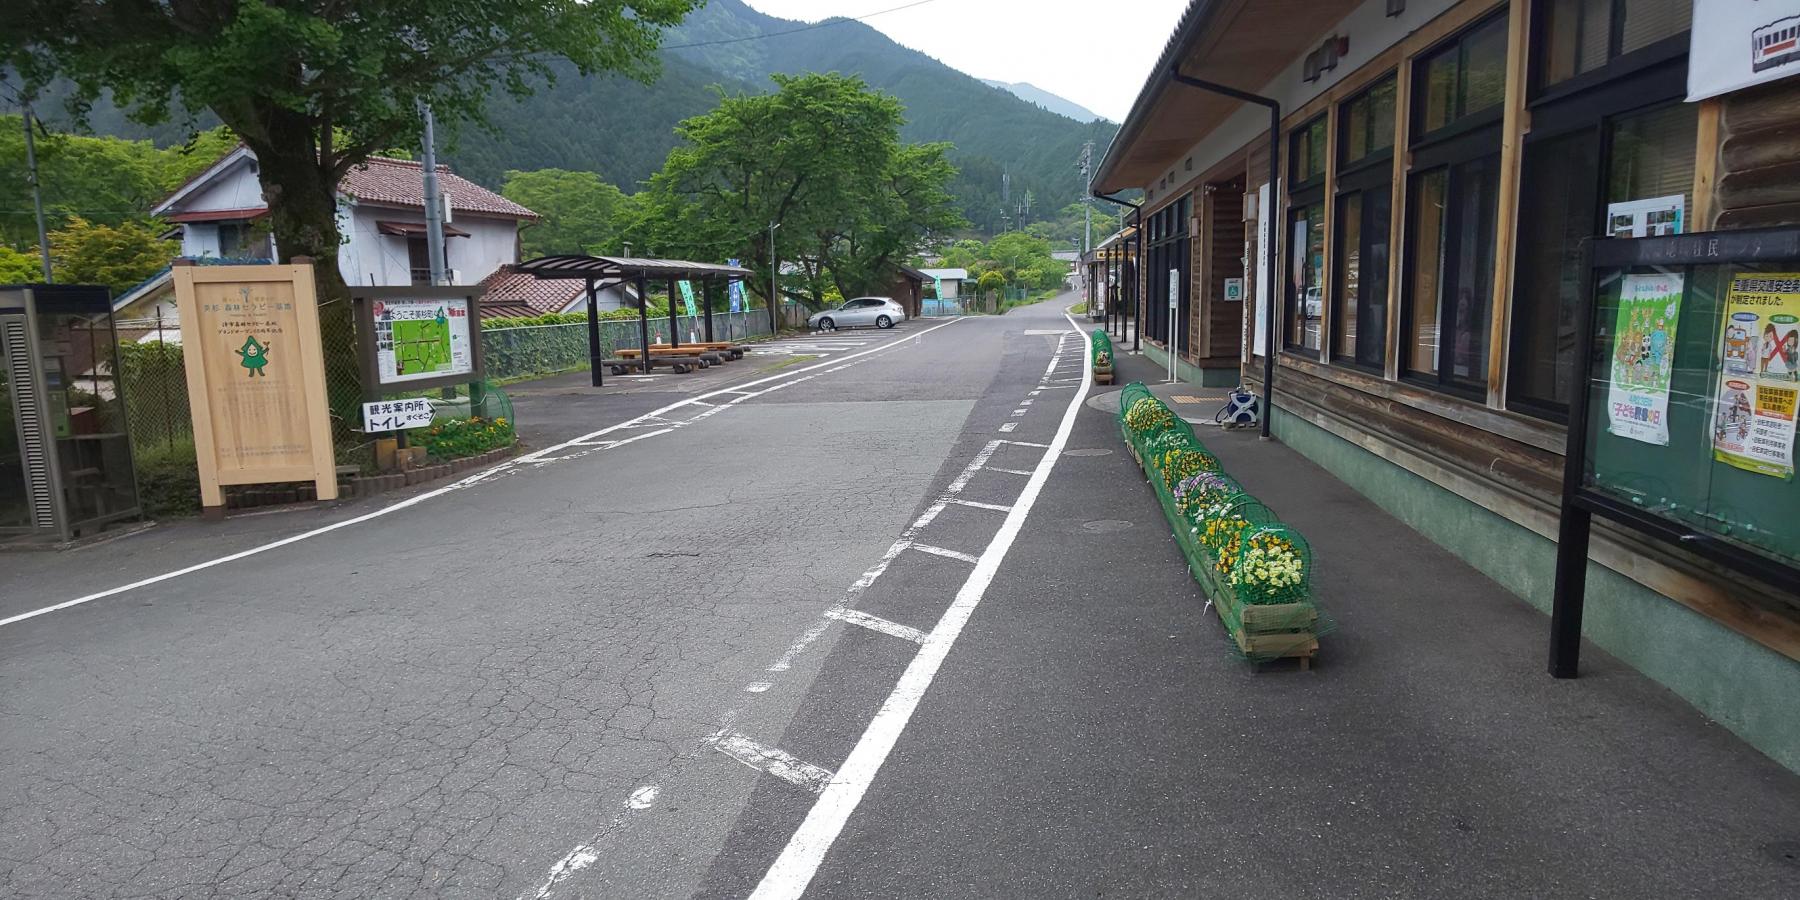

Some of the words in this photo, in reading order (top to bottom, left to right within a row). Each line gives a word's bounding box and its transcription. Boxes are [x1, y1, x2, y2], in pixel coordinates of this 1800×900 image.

[369, 400, 424, 415] 観光案内所
[369, 416, 406, 432] トイレ
[406, 412, 430, 421] すぐそこ
